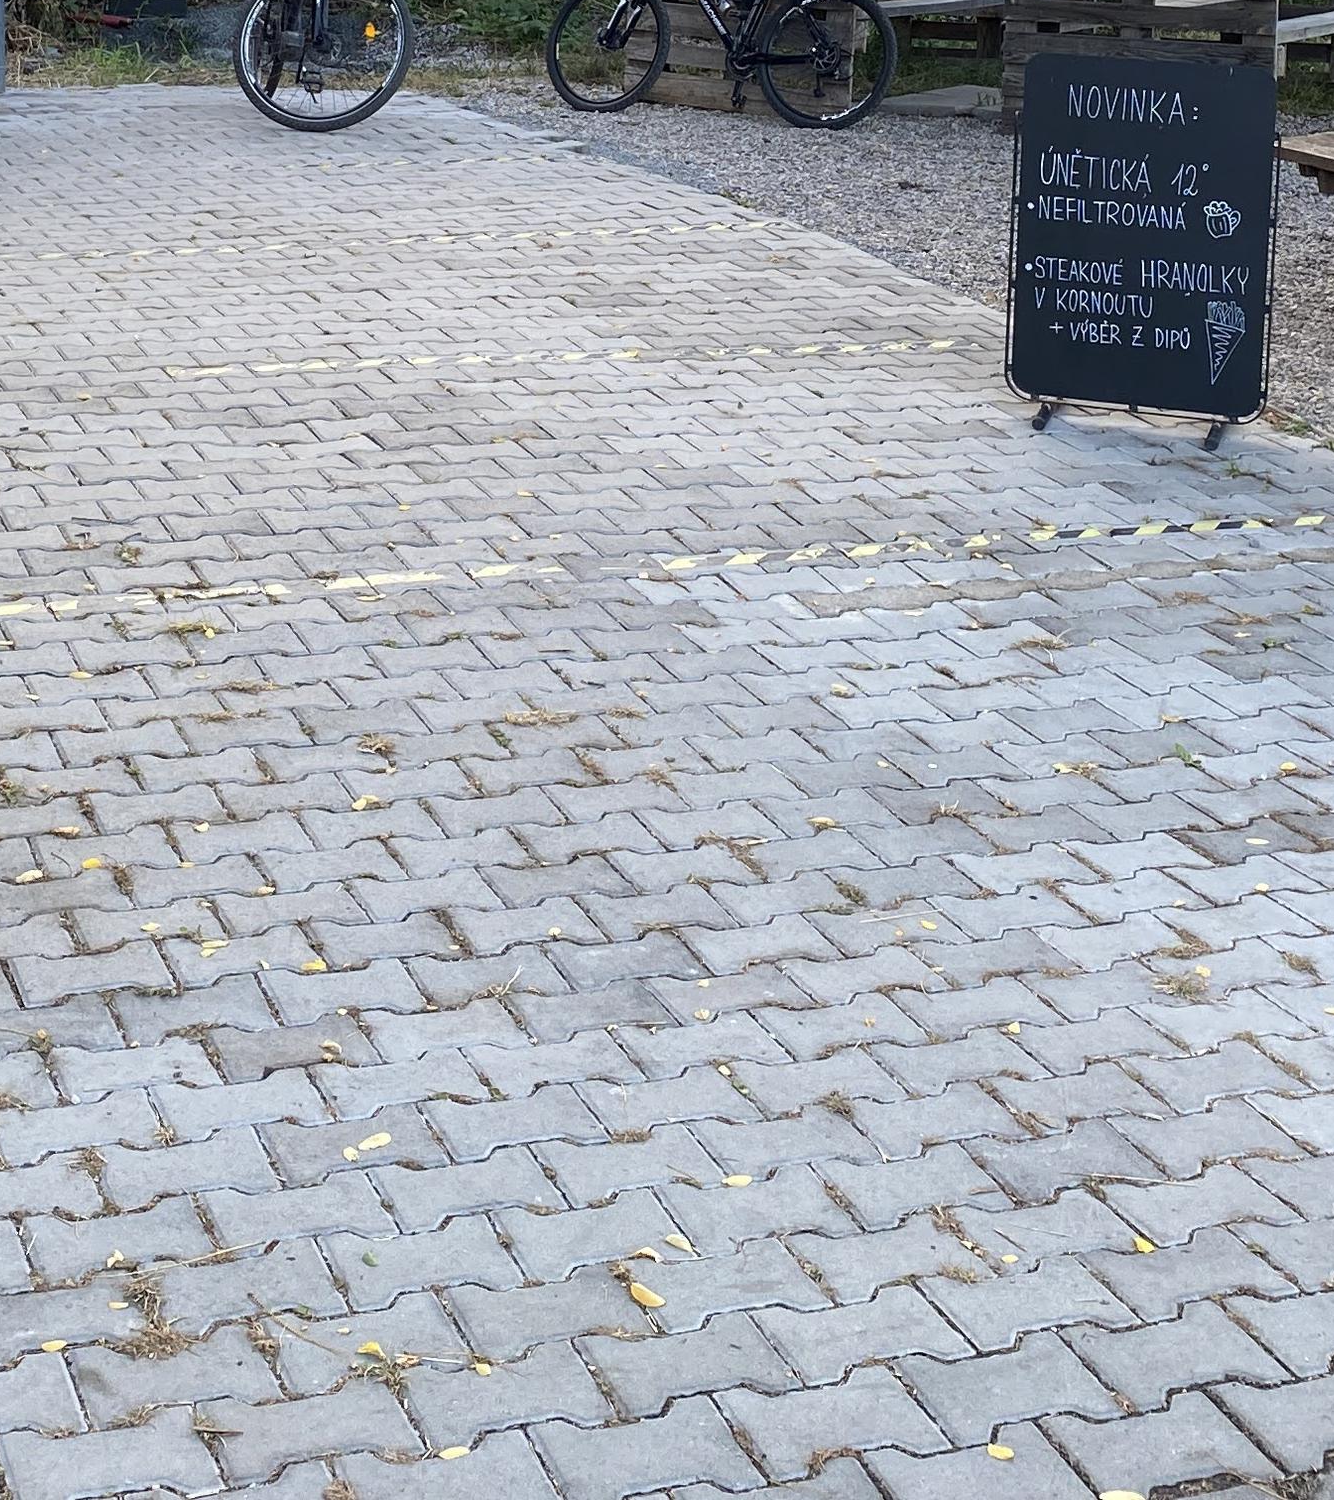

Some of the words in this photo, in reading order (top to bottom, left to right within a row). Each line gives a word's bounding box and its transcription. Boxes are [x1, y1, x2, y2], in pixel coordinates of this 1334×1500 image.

[1068, 84, 1200, 126] NOVINKA:
[1040, 146, 1152, 197] ÚNĚTICKÁ
[1038, 197, 1186, 231] NEFILTROVANÁ
[1034, 257, 1124, 286] STEAKOVÉ
[1141, 260, 1250, 296] HRANOLKY
[1034, 288, 1045, 310] V
[1056, 288, 1153, 318] KORNOUTU
[1069, 318, 1122, 346] VÝBĚR
[1131, 325, 1145, 348] Z
[1155, 327, 1191, 350] DIPŮ
